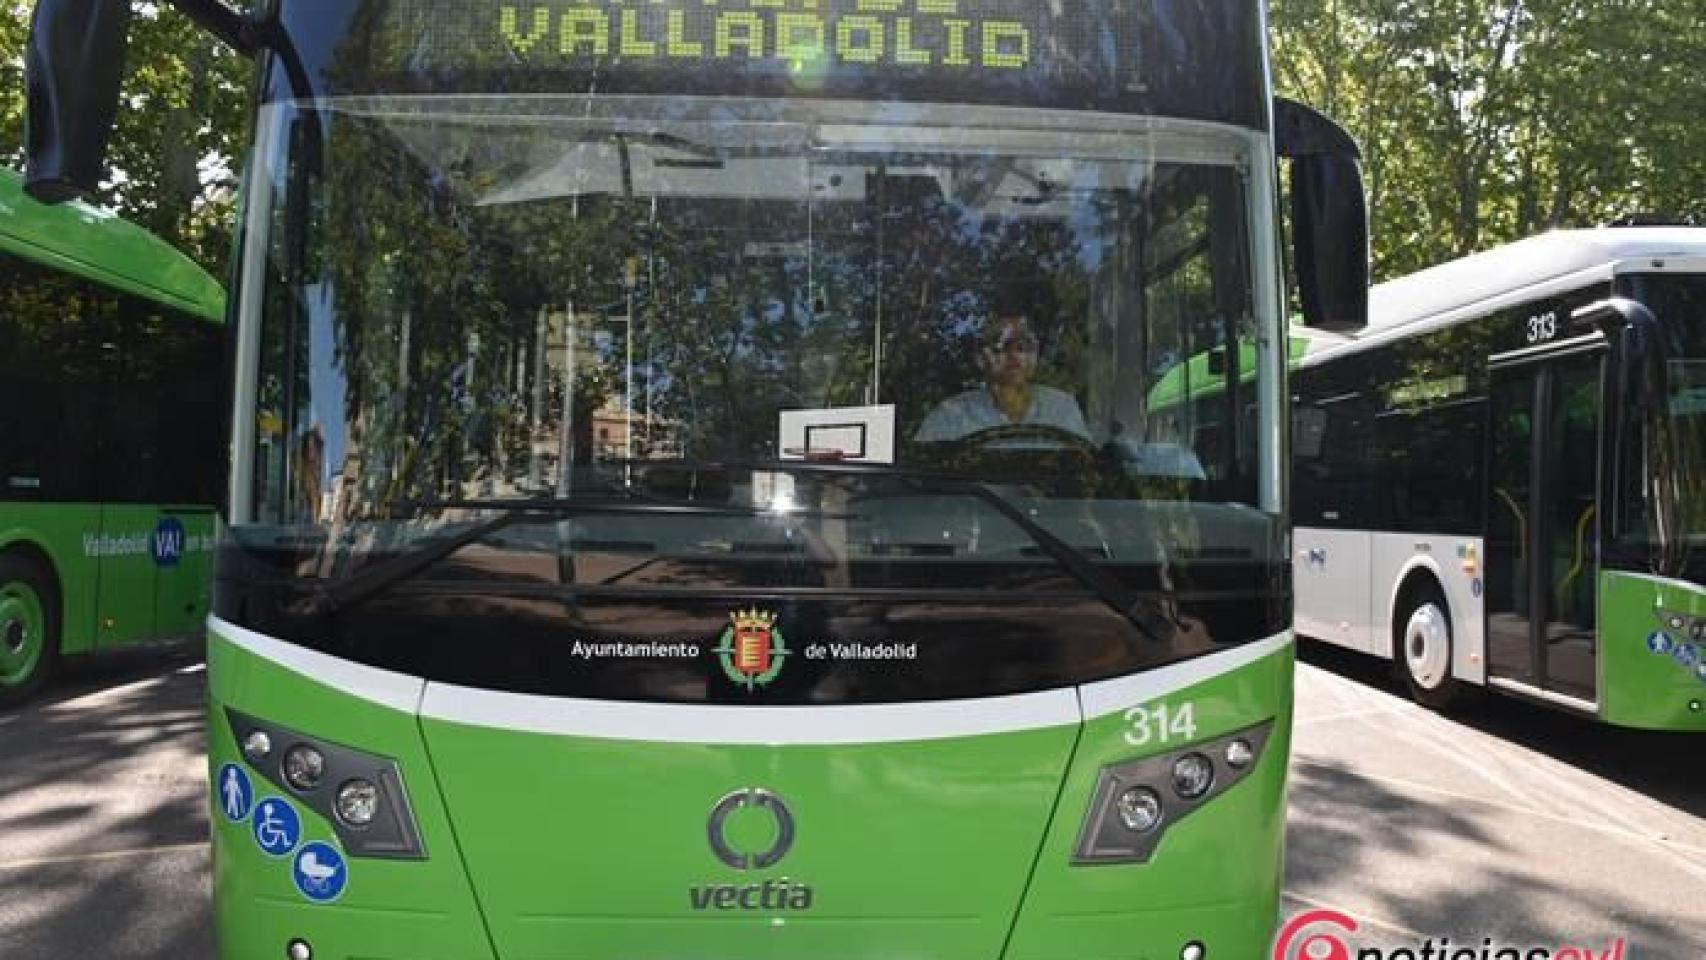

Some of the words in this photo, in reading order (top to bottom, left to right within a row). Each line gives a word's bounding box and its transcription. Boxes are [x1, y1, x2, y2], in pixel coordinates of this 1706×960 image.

[500, 7, 1031, 68] VALLADOLID
[1526, 311, 1556, 343] 313
[571, 641, 700, 660] Ayuntamiento
[805, 642, 826, 660] de
[829, 642, 918, 660] Valladolid
[1124, 702, 1198, 746] 314
[689, 876, 814, 909] vectia
